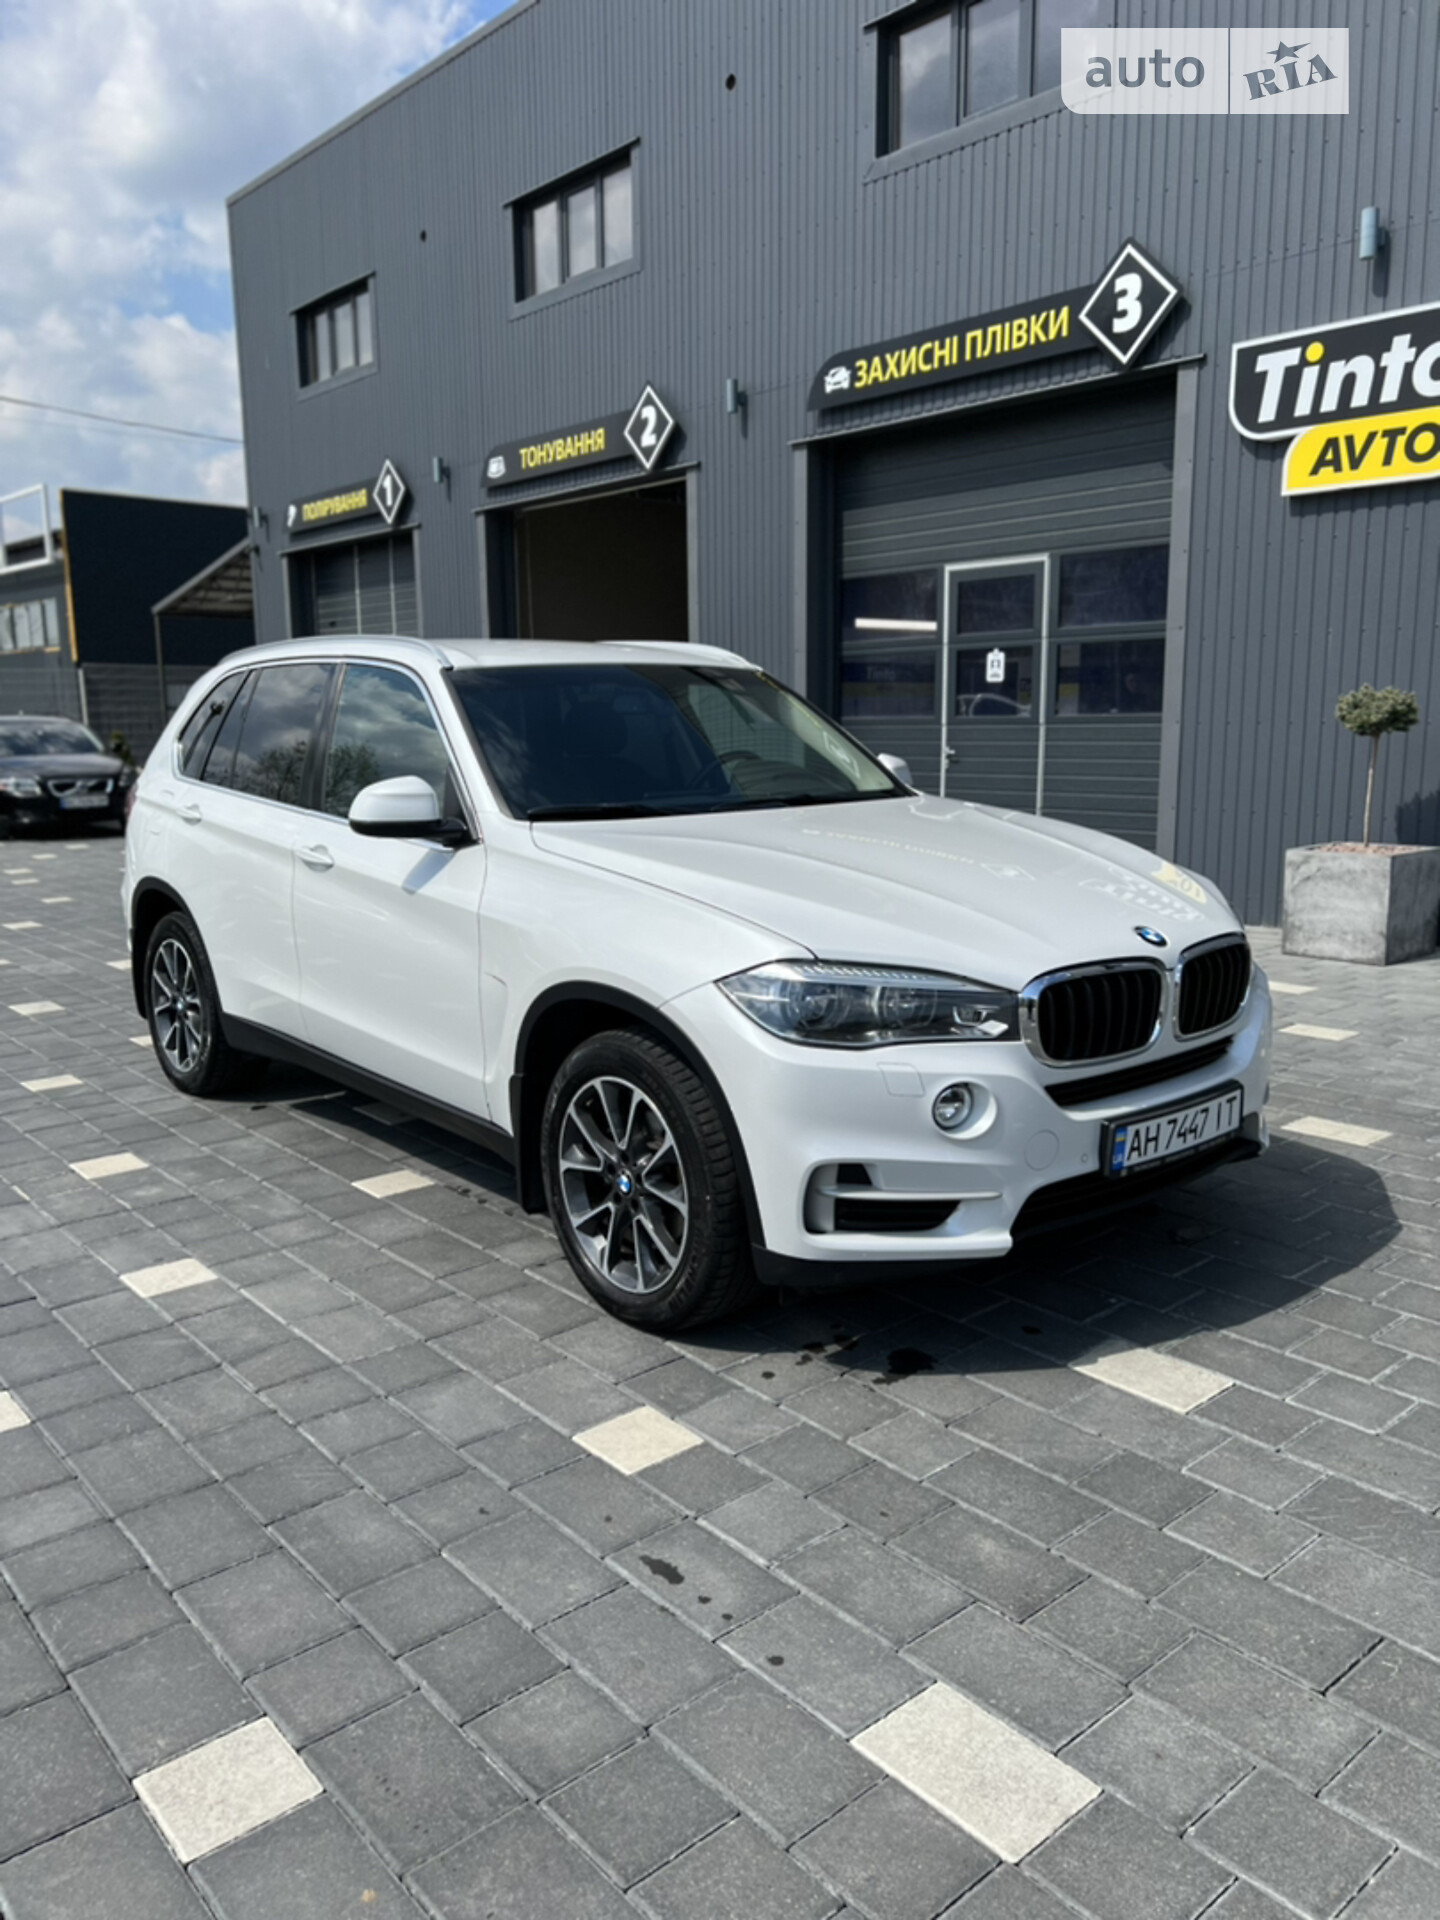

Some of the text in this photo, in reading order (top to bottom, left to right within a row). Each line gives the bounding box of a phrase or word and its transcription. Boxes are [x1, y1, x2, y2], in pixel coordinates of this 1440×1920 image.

[1111, 272, 1143, 334] 3
[854, 305, 1071, 388] ЗАХИСНІ ПЛІВКИ
[519, 427, 605, 469] ТОНУВАННЯ
[640, 404, 657, 448] 2
[382, 474, 392, 507] 1
[1127, 1123, 1161, 1160] AH
[1165, 1107, 1210, 1150] 7447
